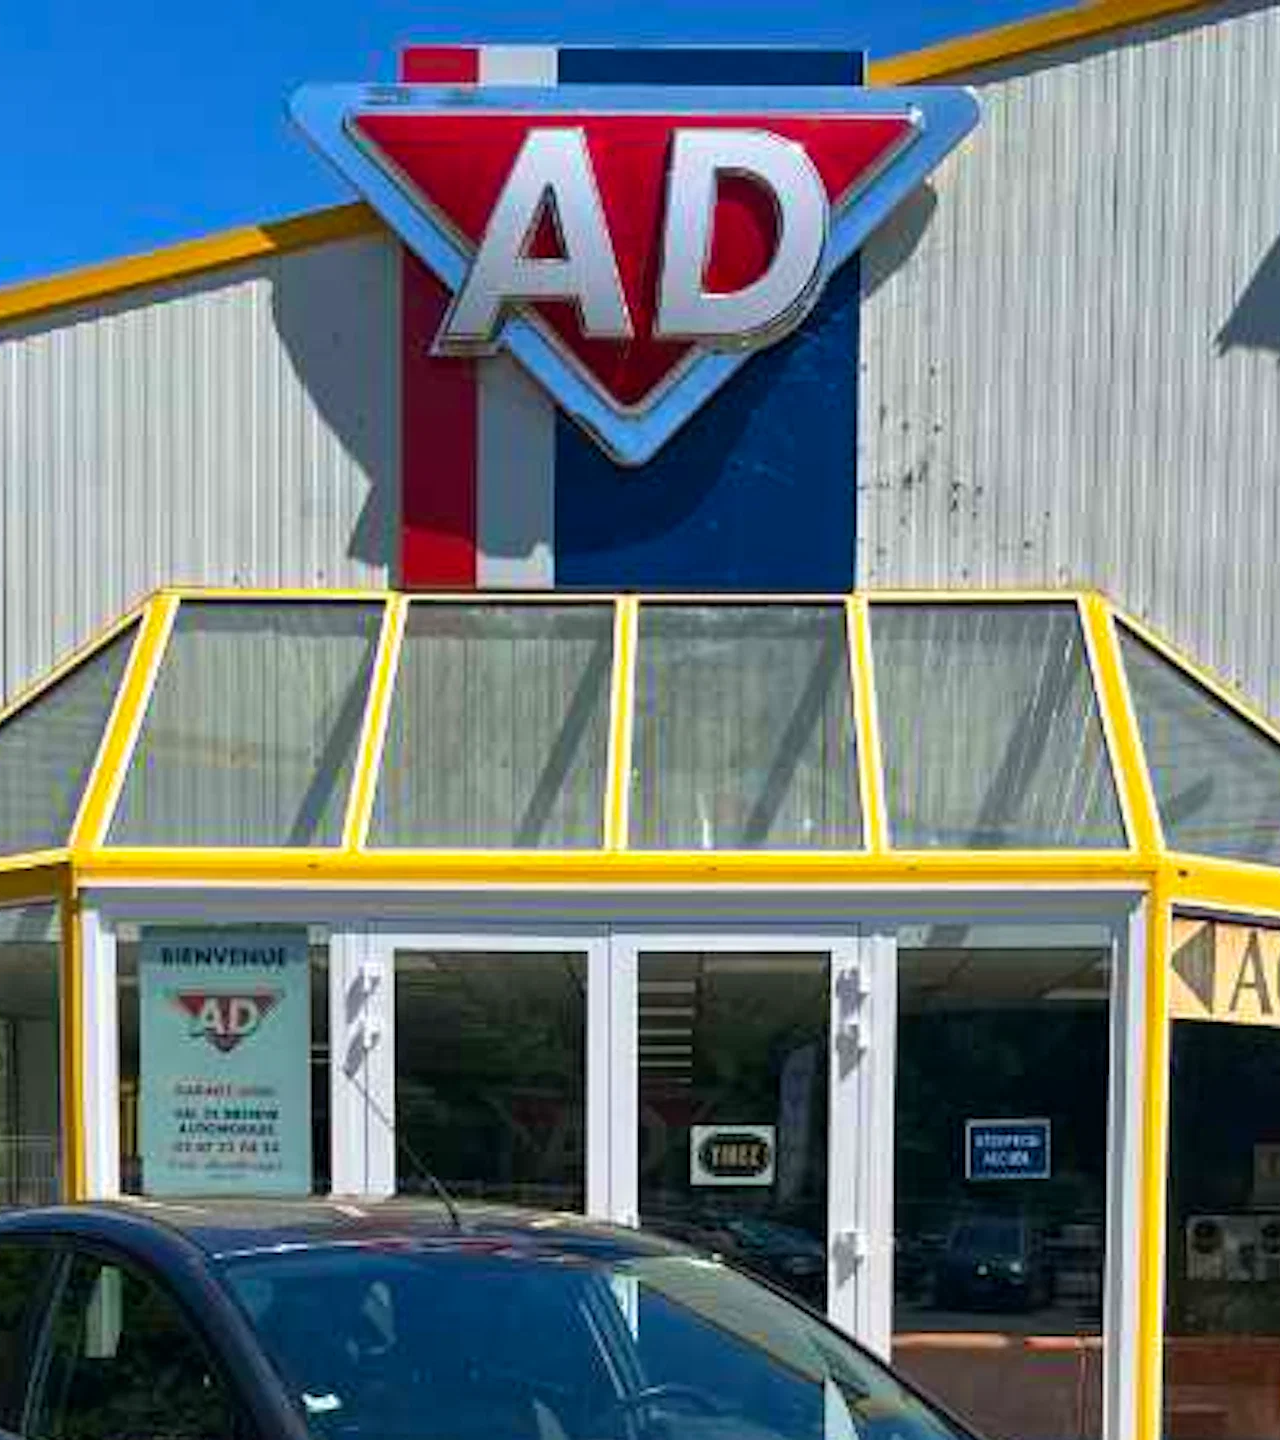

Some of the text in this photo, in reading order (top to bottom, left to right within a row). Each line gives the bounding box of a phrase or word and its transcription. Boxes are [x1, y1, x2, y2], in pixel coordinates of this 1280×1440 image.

[429, 126, 832, 356] AD
[161, 947, 286, 967] BIENVENUE
[196, 997, 259, 1036] AD
